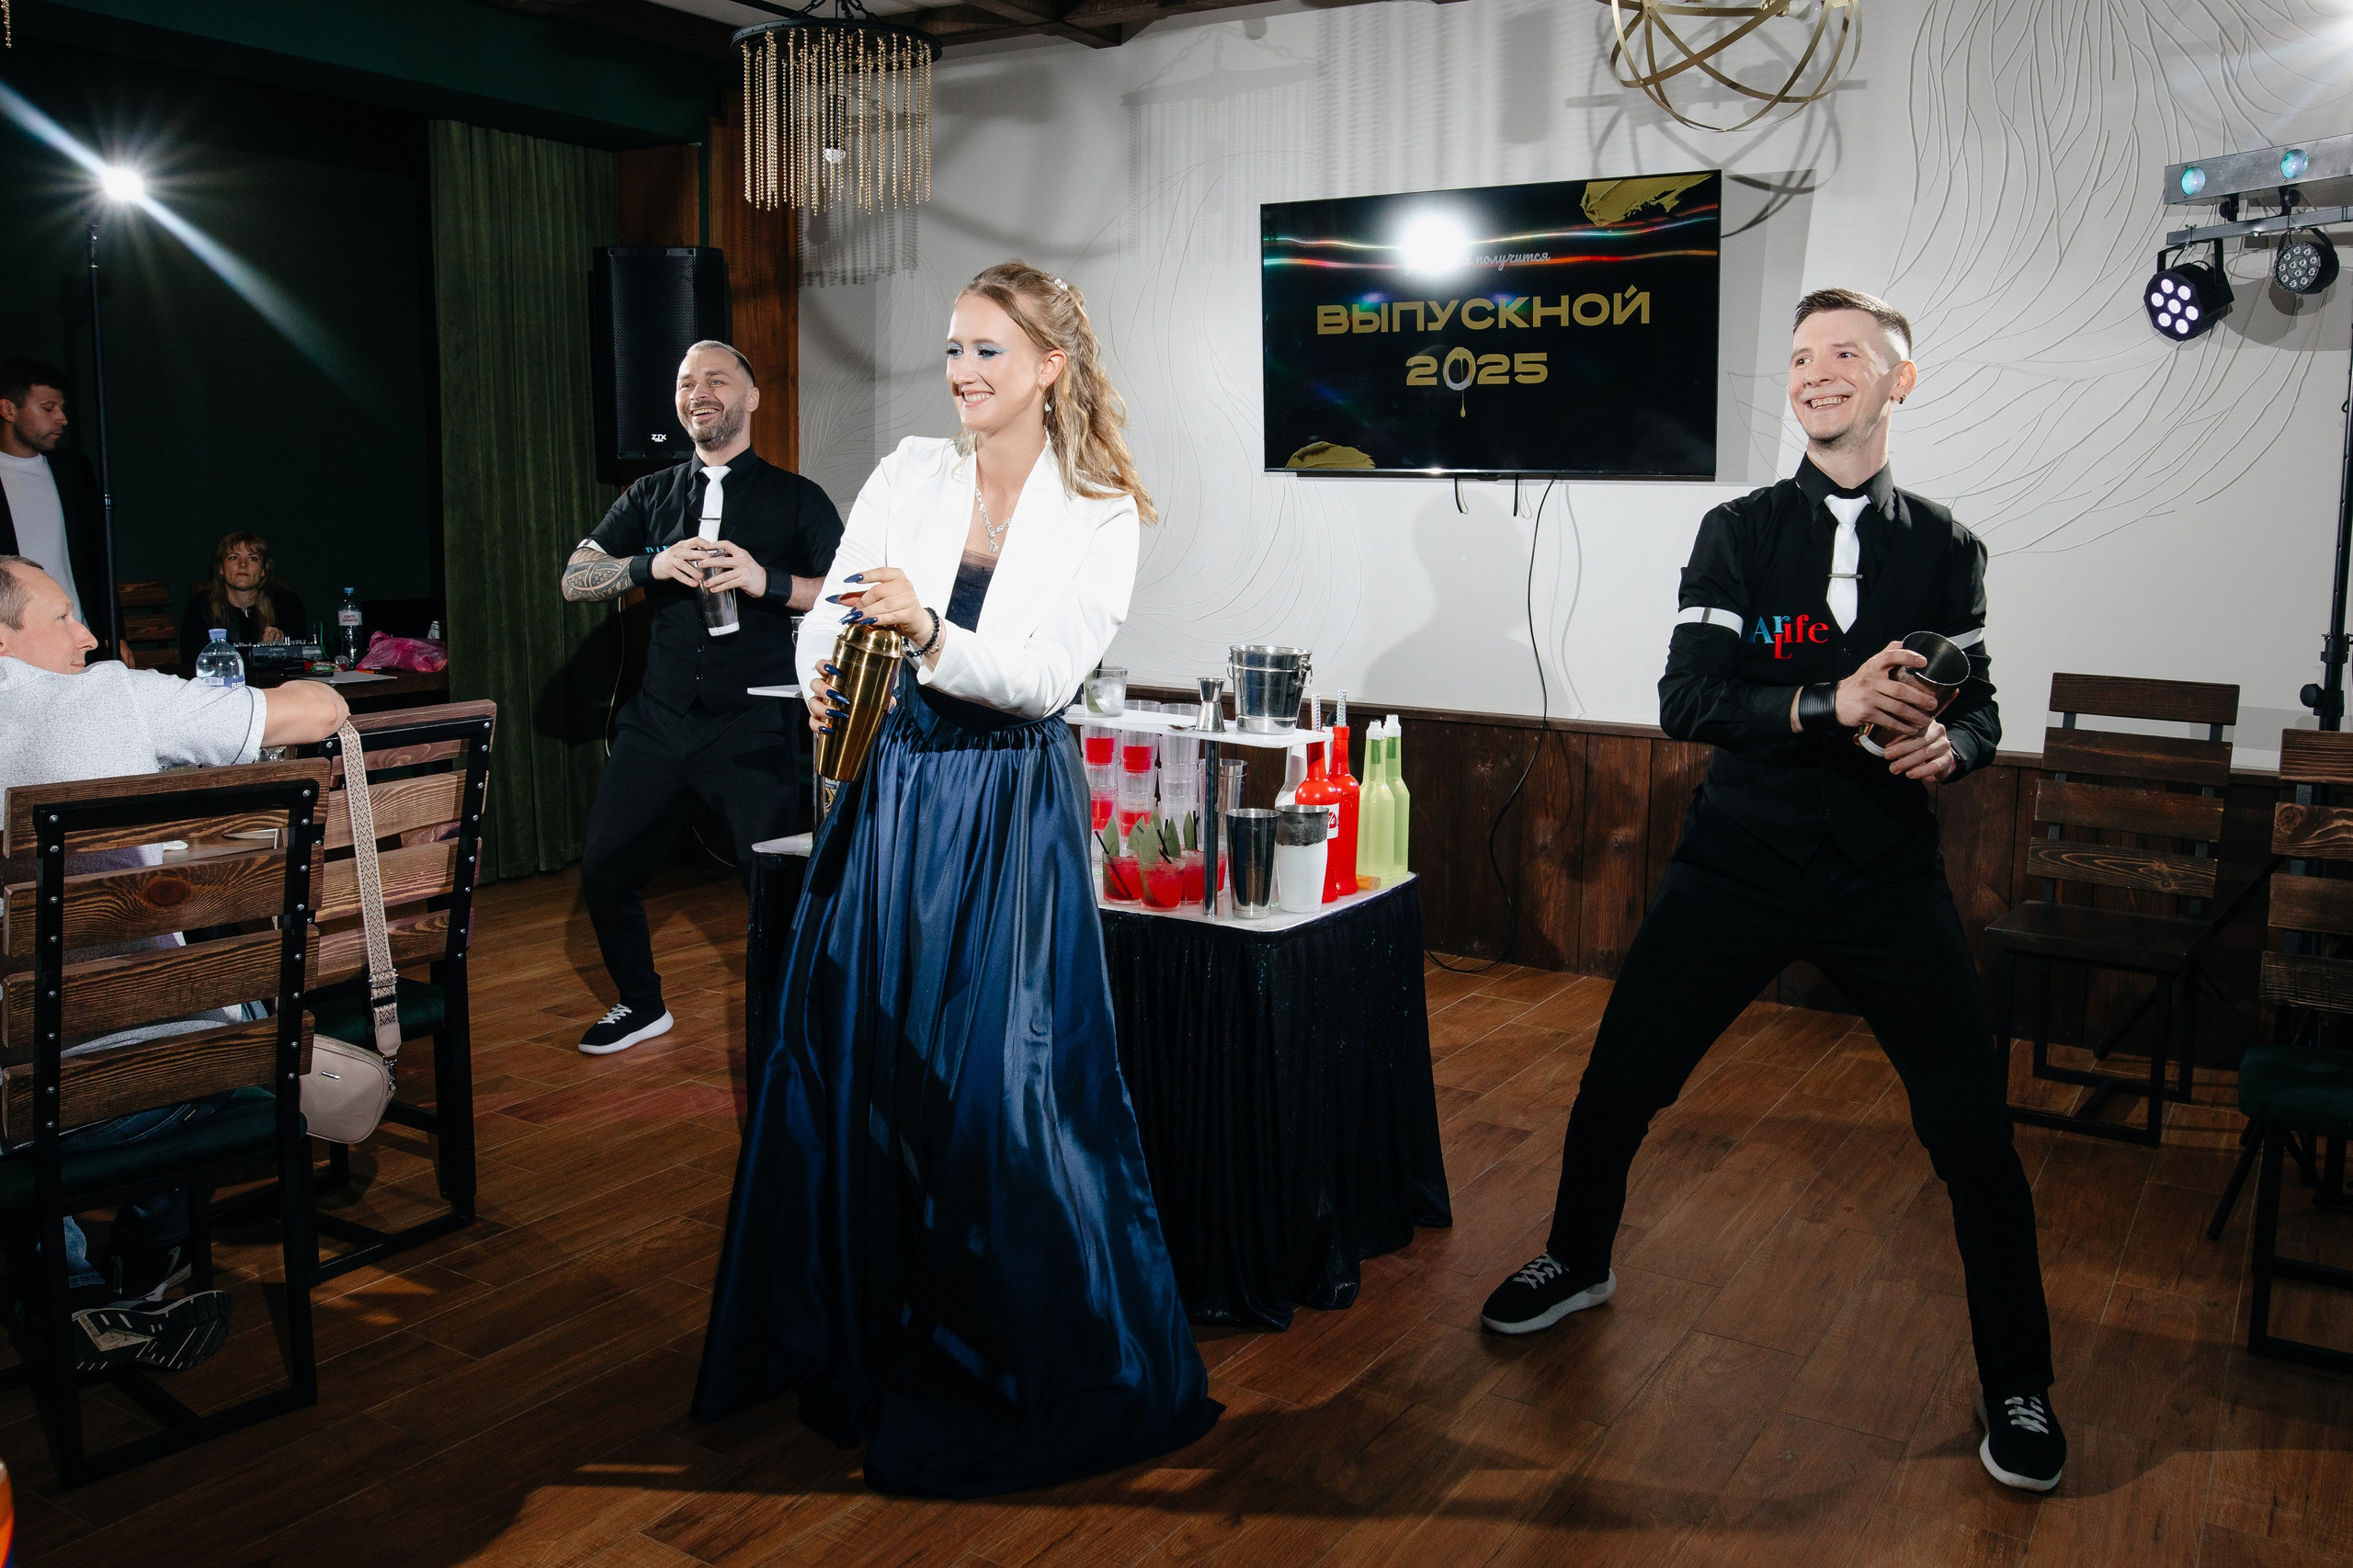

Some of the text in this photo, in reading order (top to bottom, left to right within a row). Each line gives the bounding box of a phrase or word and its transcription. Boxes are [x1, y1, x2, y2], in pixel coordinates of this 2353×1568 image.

[1475, 252, 1552, 272] получится
[1317, 284, 1651, 335] ВЫПУСКНОЙ
[1405, 347, 1549, 391] 2025
